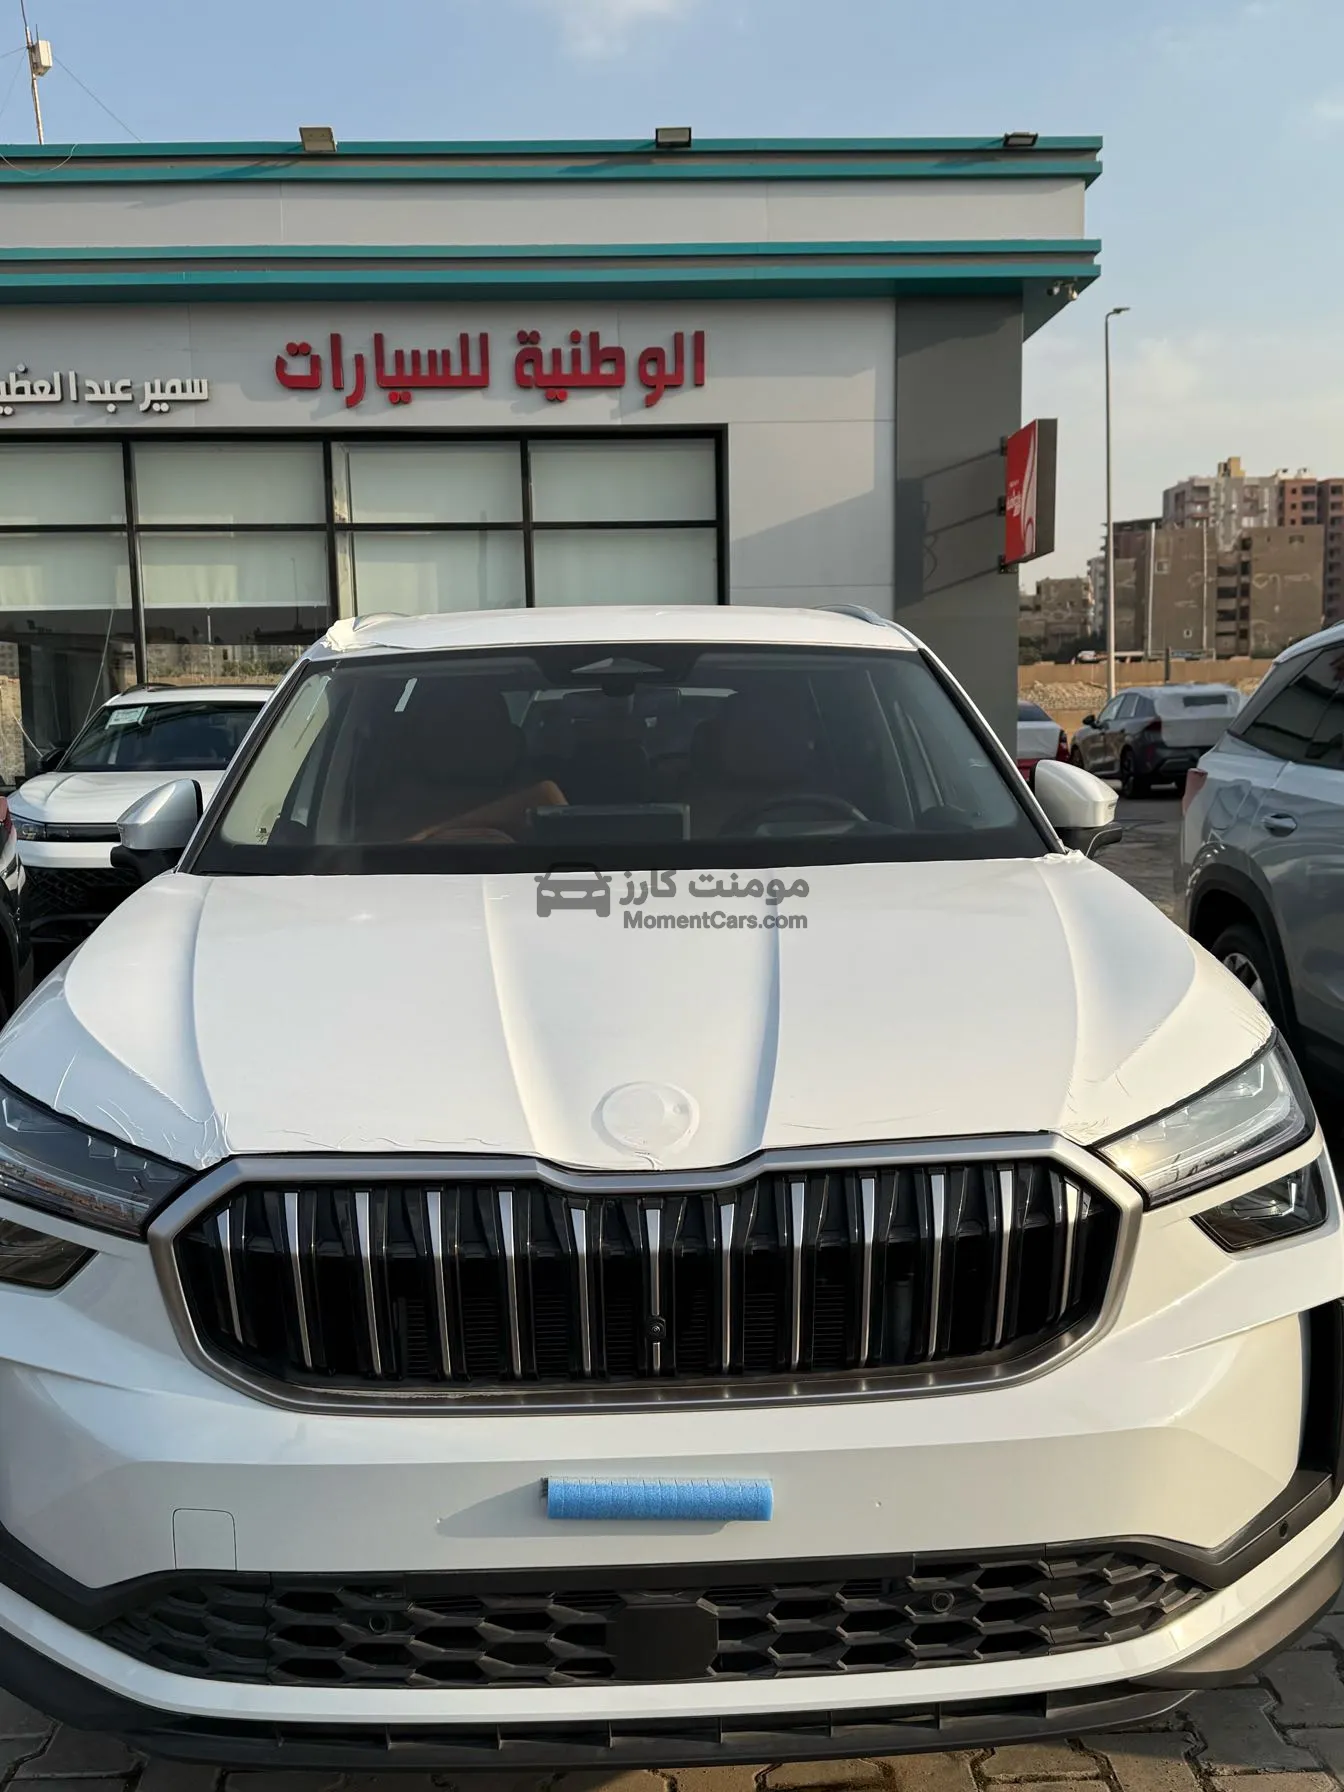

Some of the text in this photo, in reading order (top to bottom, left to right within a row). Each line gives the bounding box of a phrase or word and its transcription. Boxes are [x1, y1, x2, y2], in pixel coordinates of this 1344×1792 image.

[0, 364, 208, 415] سمير عبد العظي
[275, 330, 705, 407] الوطنية للسيارات
